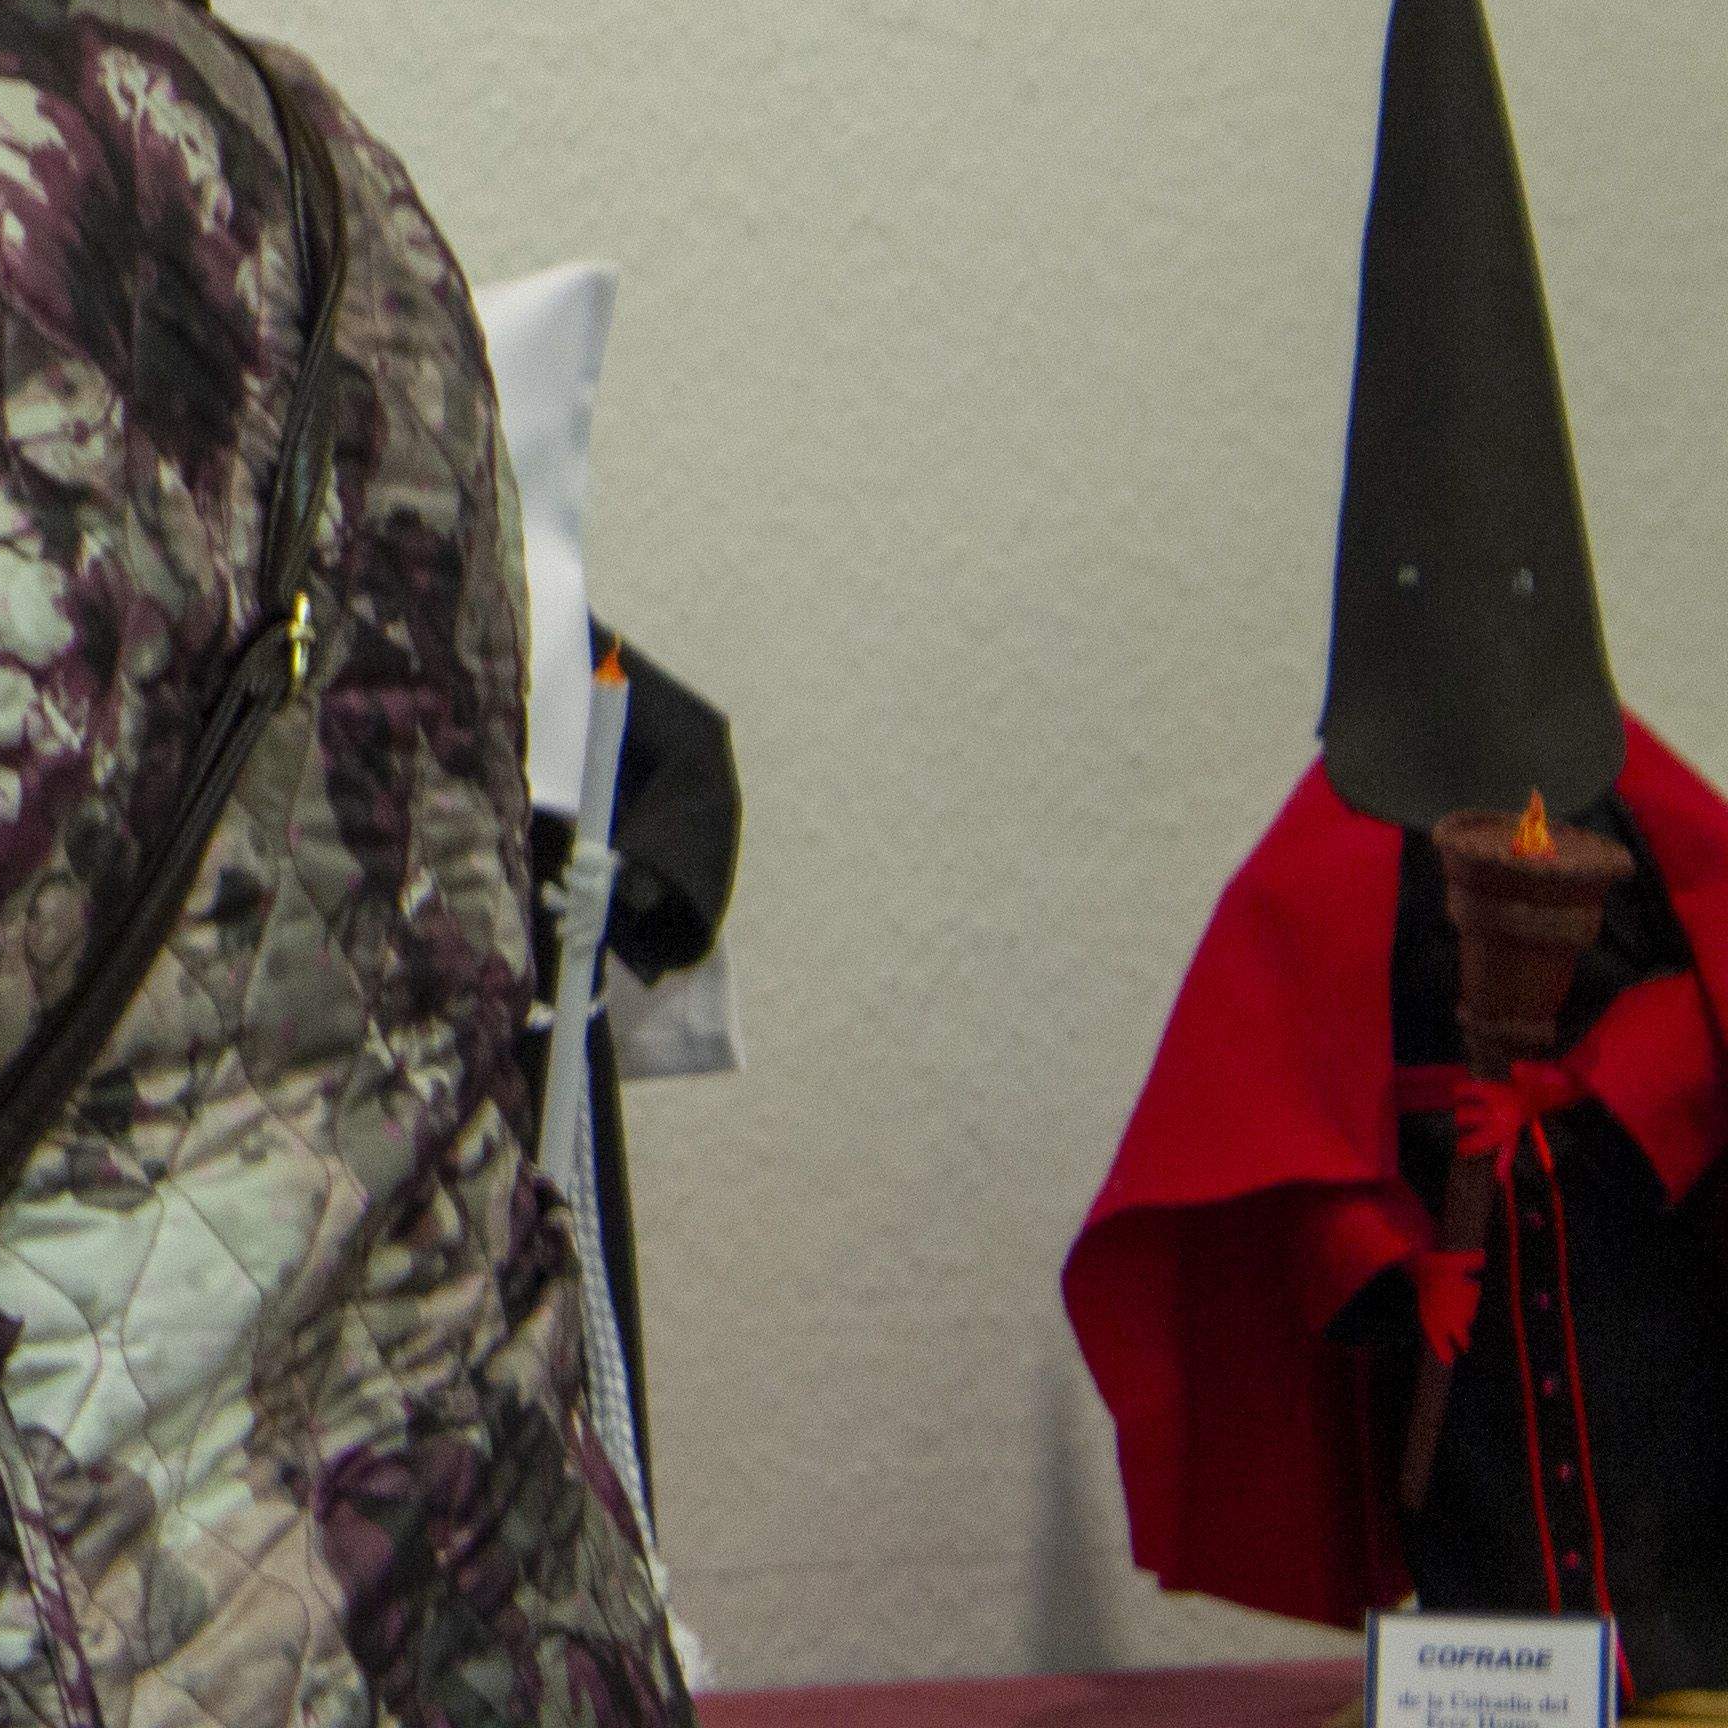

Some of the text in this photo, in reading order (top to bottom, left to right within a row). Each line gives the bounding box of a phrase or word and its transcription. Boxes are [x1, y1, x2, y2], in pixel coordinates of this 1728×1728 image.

[1418, 1644, 1552, 1670] COFRADE
[1398, 1690, 1419, 1709] de
[1428, 1691, 1443, 1710] la
[1539, 1694, 1568, 1713] del
